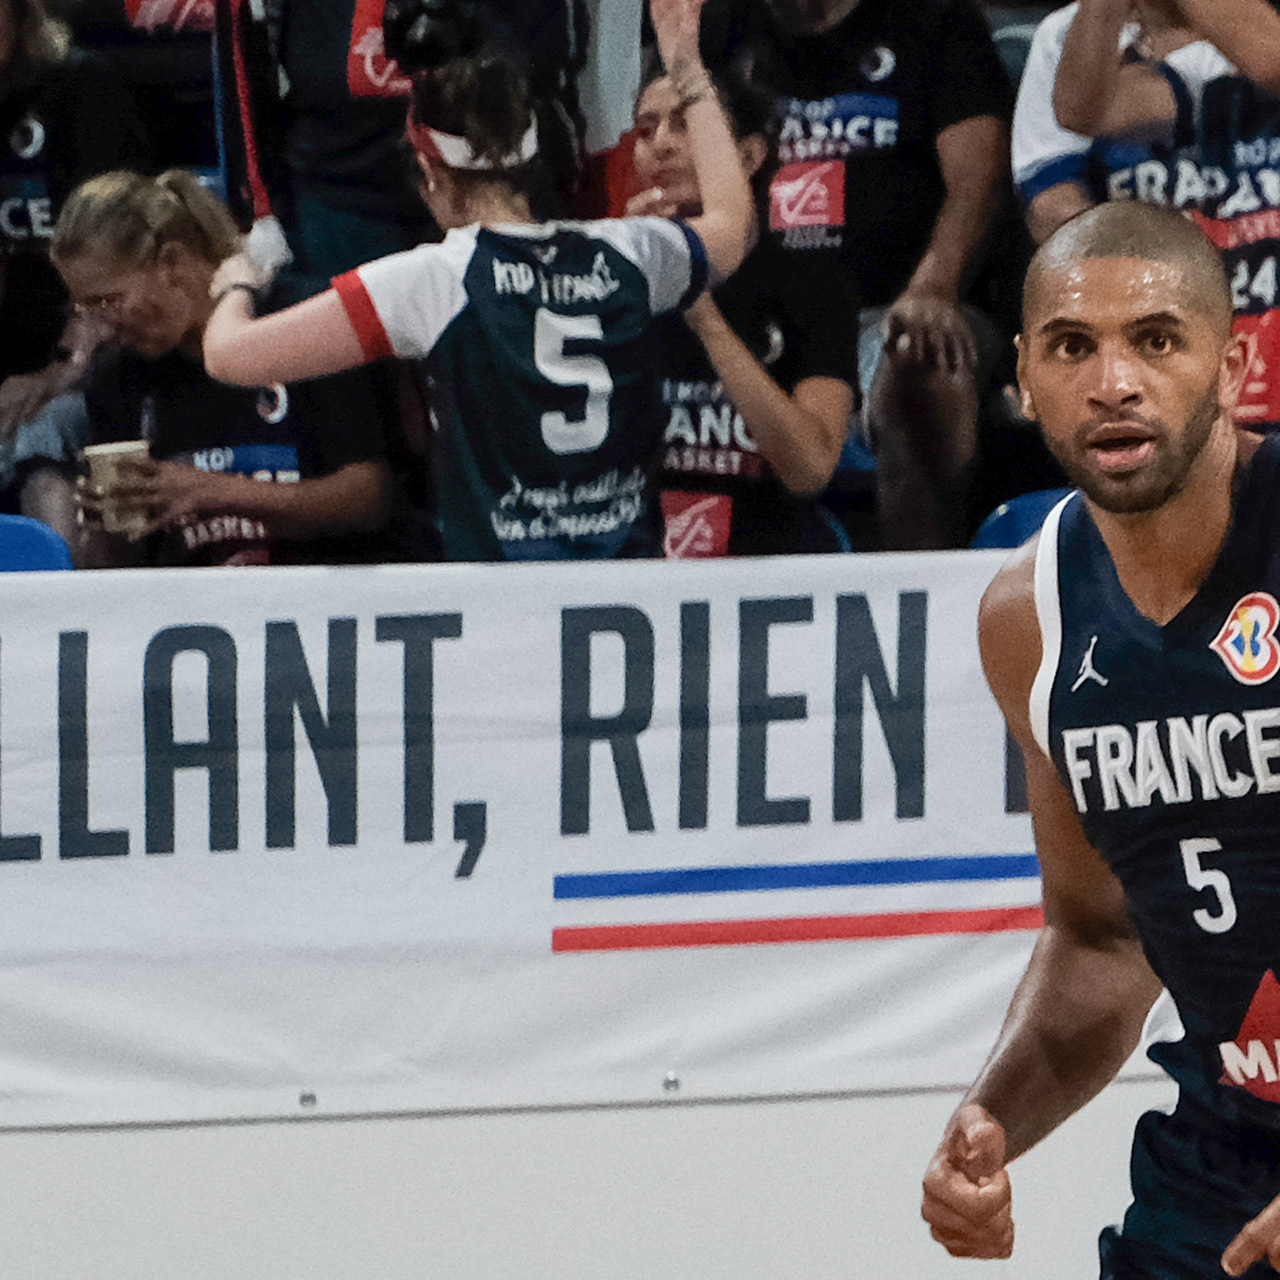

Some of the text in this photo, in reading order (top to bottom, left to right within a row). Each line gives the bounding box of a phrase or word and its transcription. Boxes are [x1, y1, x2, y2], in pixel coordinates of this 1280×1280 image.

[534, 307, 614, 455] 5
[560, 589, 929, 836] RIEN
[1179, 836, 1238, 934] 5
